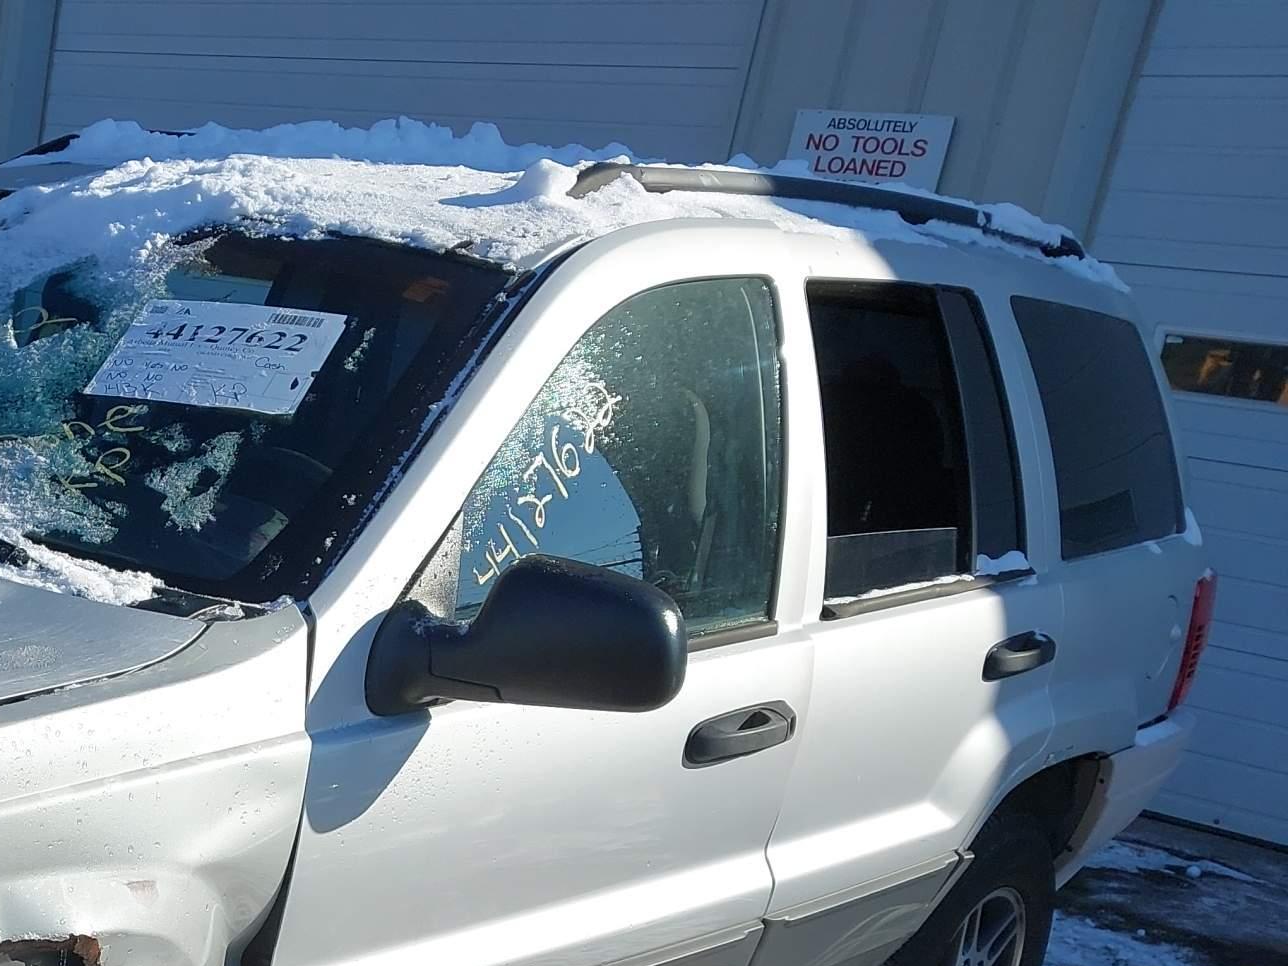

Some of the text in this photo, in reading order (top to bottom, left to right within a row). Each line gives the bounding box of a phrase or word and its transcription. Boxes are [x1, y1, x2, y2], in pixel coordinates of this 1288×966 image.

[827, 117, 919, 133] ABSOLUTELY
[805, 132, 929, 158] NO TOOLS
[814, 155, 907, 178] LOANED
[145, 321, 309, 352] 44127622
[472, 382, 623, 585] 44127622
